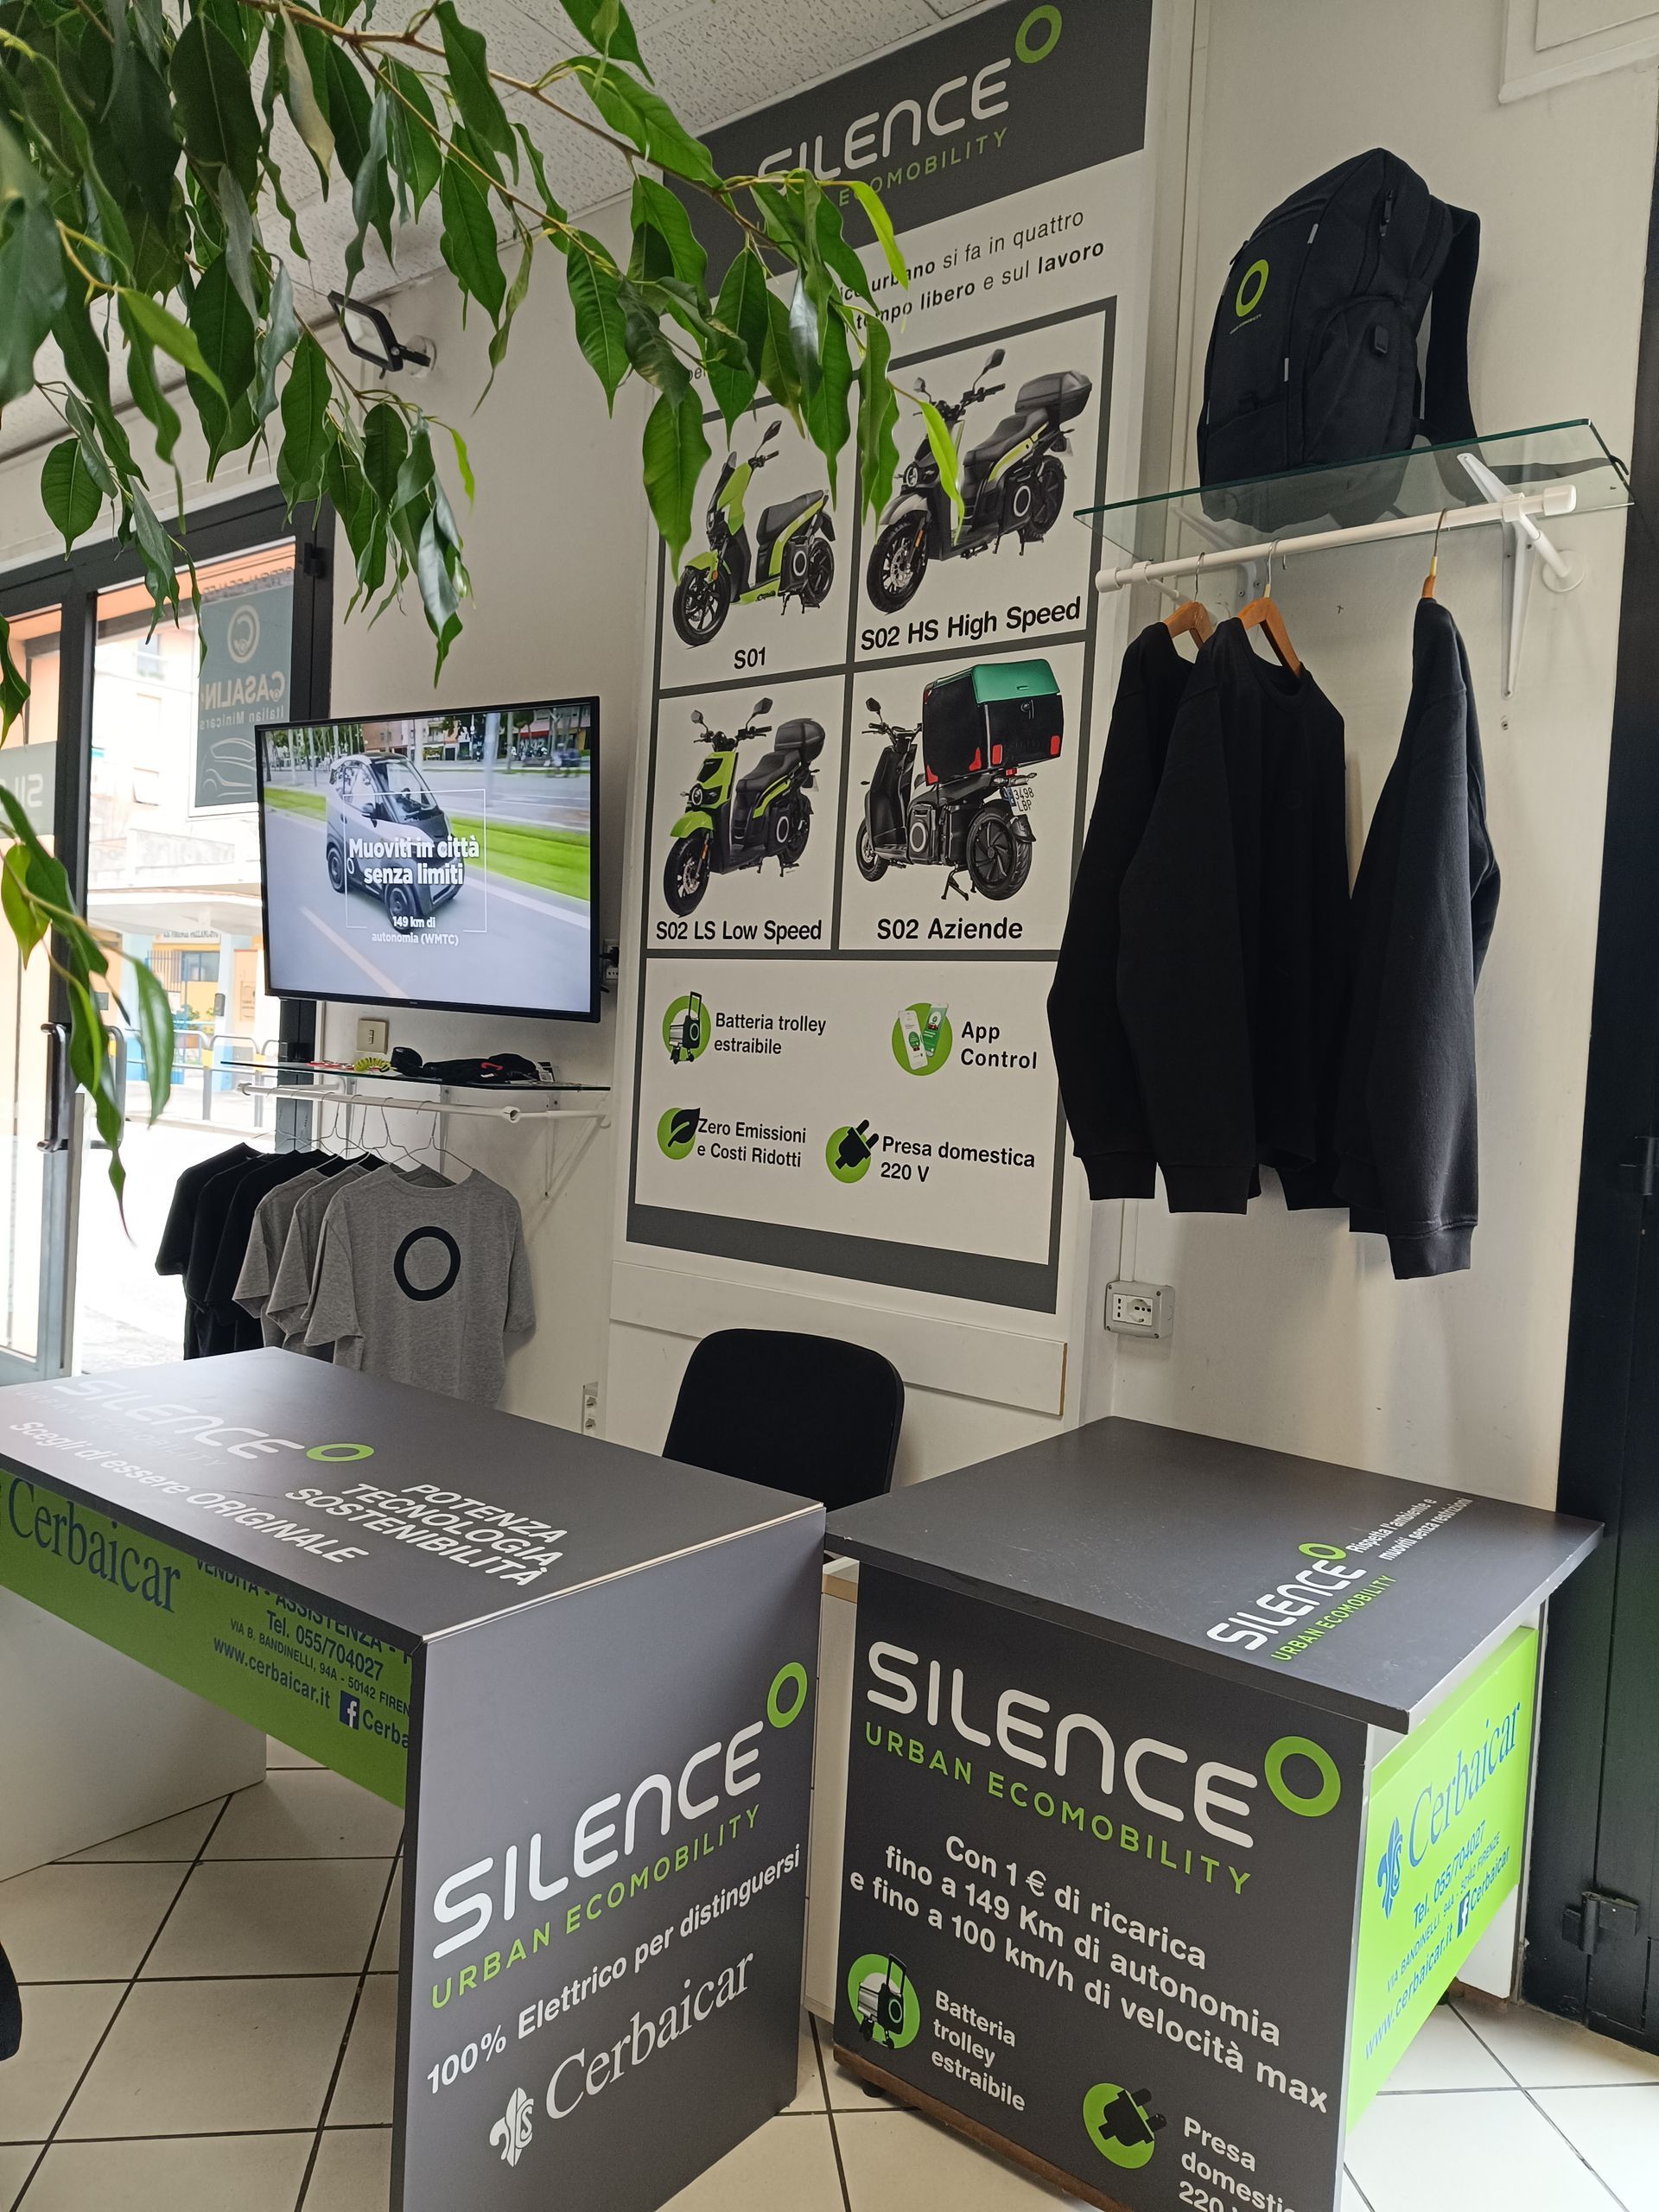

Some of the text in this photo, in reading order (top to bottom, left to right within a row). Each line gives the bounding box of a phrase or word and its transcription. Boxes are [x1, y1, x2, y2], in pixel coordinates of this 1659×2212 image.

[943, 245, 958, 269] si
[965, 244, 981, 262] fa
[989, 236, 1005, 254] in
[1013, 210, 1084, 247] quattro
[857, 240, 1103, 329] tmpo libero e sul lavoro
[861, 596, 1082, 652] S02 HS High Speed
[734, 647, 766, 669] S01
[1014, 787, 1034, 800] 3498
[349, 835, 480, 858] Muoviti in città
[364, 862, 464, 885] senza limiti
[372, 931, 459, 946] autonomia (WMTC)
[392, 916, 436, 928] 149 km di
[657, 920, 823, 944] S02 LS Low Speed
[877, 918, 1023, 940] S02 Aziende
[714, 1038, 782, 1056] estraibile
[715, 1012, 826, 1036] Batteria trolley
[961, 1021, 1001, 1043] App
[961, 1048, 1038, 1070] Control
[696, 1142, 802, 1168] e Costi Ridotti
[697, 1117, 806, 1144] Zero Emissioni
[882, 1136, 1035, 1168] Presa domestica
[880, 1161, 930, 1183] 220 V
[52, 1379, 305, 1460] SILENCE
[9, 1421, 369, 1563] Scegli di essere ORIGINALE
[403, 1484, 567, 1544] POTENZA
[9, 1476, 181, 1614] Cerbaicar
[286, 1487, 548, 1586] SOSTENIBILITÀ
[341, 1484, 563, 1568] TECNOLOGIA
[1345, 1529, 1394, 1554] Rispetta
[1380, 1503, 1431, 1530] l'ambiente
[1377, 1536, 1417, 1561] muoviti
[1408, 1522, 1440, 1540] senza
[1206, 1559, 1367, 1650] SILENCE
[1271, 1574, 1397, 1661] URBAN ECOMOBILITY
[213, 1637, 331, 1709] www.cerbaicar.it
[231, 1618, 245, 1635] VIA
[247, 1627, 256, 1641] B.
[259, 1634, 316, 1672] BANDINELLI,
[320, 1662, 337, 1680] 94A
[348, 1676, 375, 1700] 50142
[267, 1610, 384, 1681] Tel. 055/704027
[867, 1641, 1258, 1848] SILENCE
[865, 1721, 1251, 1895] URBAN ECOMOBILITY
[1408, 1701, 1522, 1868] Cerbaicar
[433, 1720, 764, 1960] SILENCE
[946, 1835, 1207, 1970] Con 1 € di ricarica
[1414, 1820, 1485, 1929] Tel. 055/704027
[1471, 1845, 1510, 1910] Cerbaicar
[432, 1804, 760, 2009] URBAN ECOMOBILITY
[427, 1843, 800, 2094] 100% Elettrico per distinguersi
[885, 1846, 1281, 2048] fino a 149 Km di autonomia
[850, 1871, 1327, 2113] e fino a 100 km/h di velocità max
[1365, 1923, 1453, 2061] www.cerbaicar.it
[1387, 1969, 1399, 1993] VIA
[546, 1953, 753, 2120] Cerbaicar
[932, 2018, 996, 2069] trolley
[934, 1989, 1016, 2048] Batteria
[931, 2050, 1027, 2113] estraibile
[1184, 2116, 1255, 2172] Presa
[1179, 2181, 1224, 2212] 220
